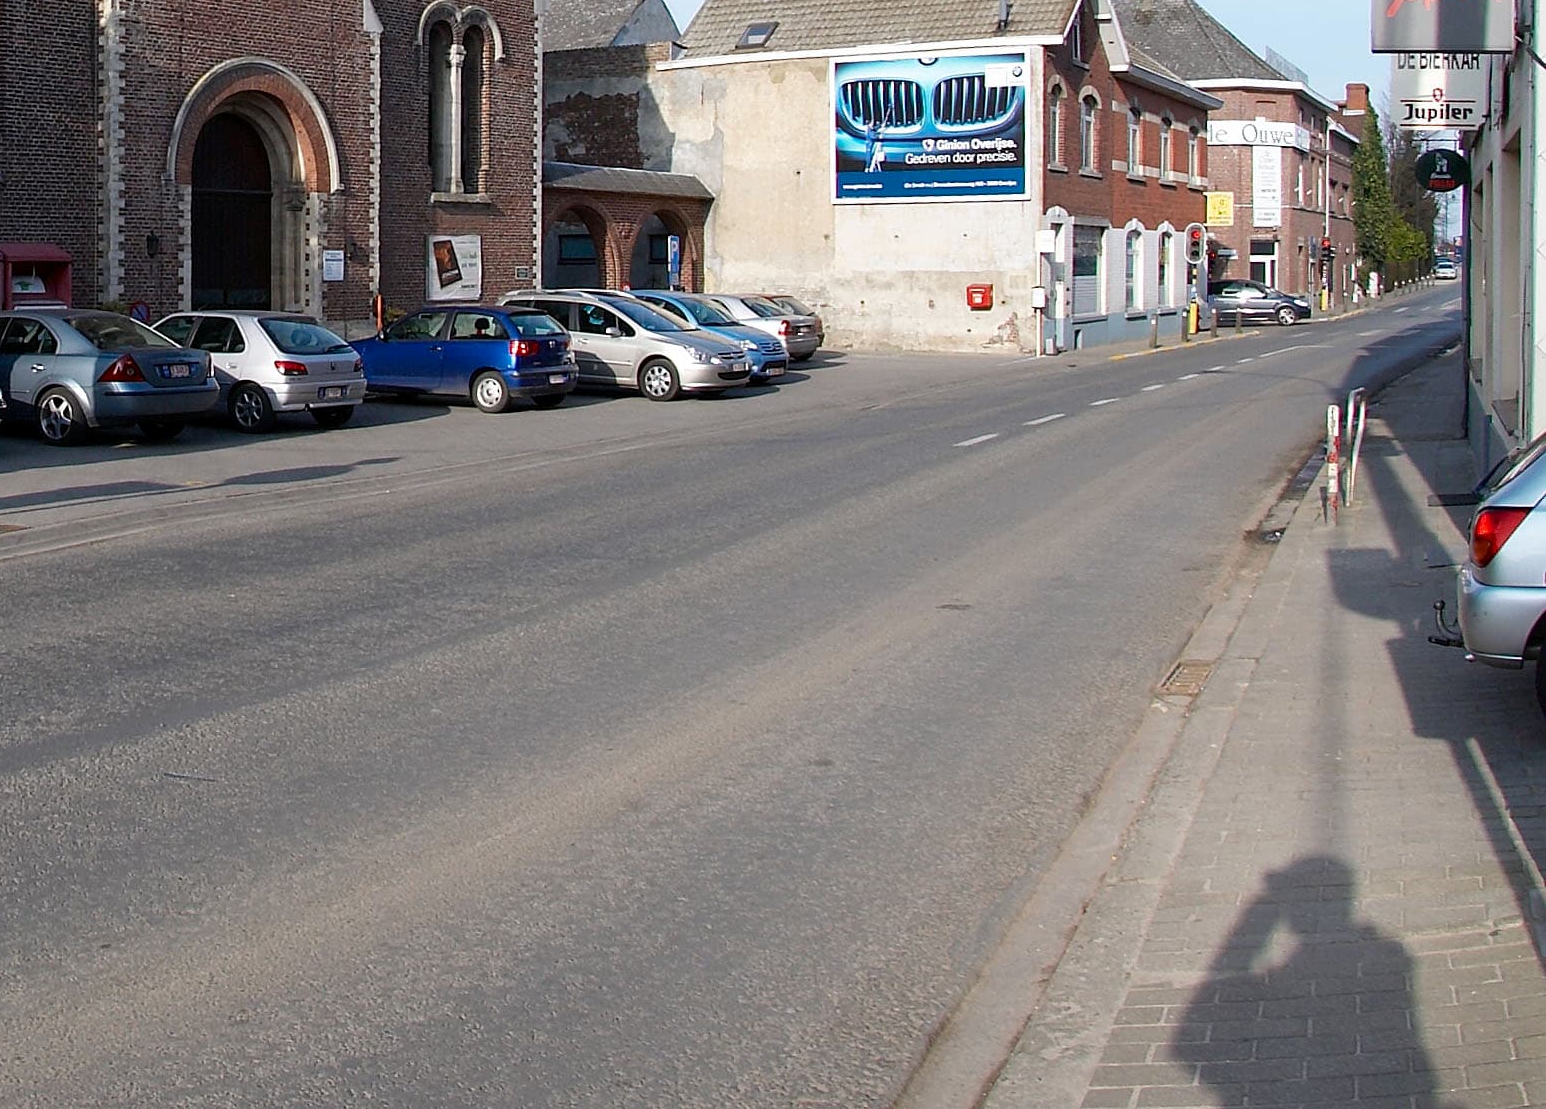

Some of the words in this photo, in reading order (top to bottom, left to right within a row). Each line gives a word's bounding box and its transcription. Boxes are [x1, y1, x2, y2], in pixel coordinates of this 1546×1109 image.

[1398, 53, 1415, 70] DE
[1403, 103, 1473, 122] Jupiler
[1242, 123, 1294, 145] Ouwe
[905, 153, 951, 165] Gedreven
[952, 151, 975, 163] door
[976, 150, 1018, 164] precisie.
